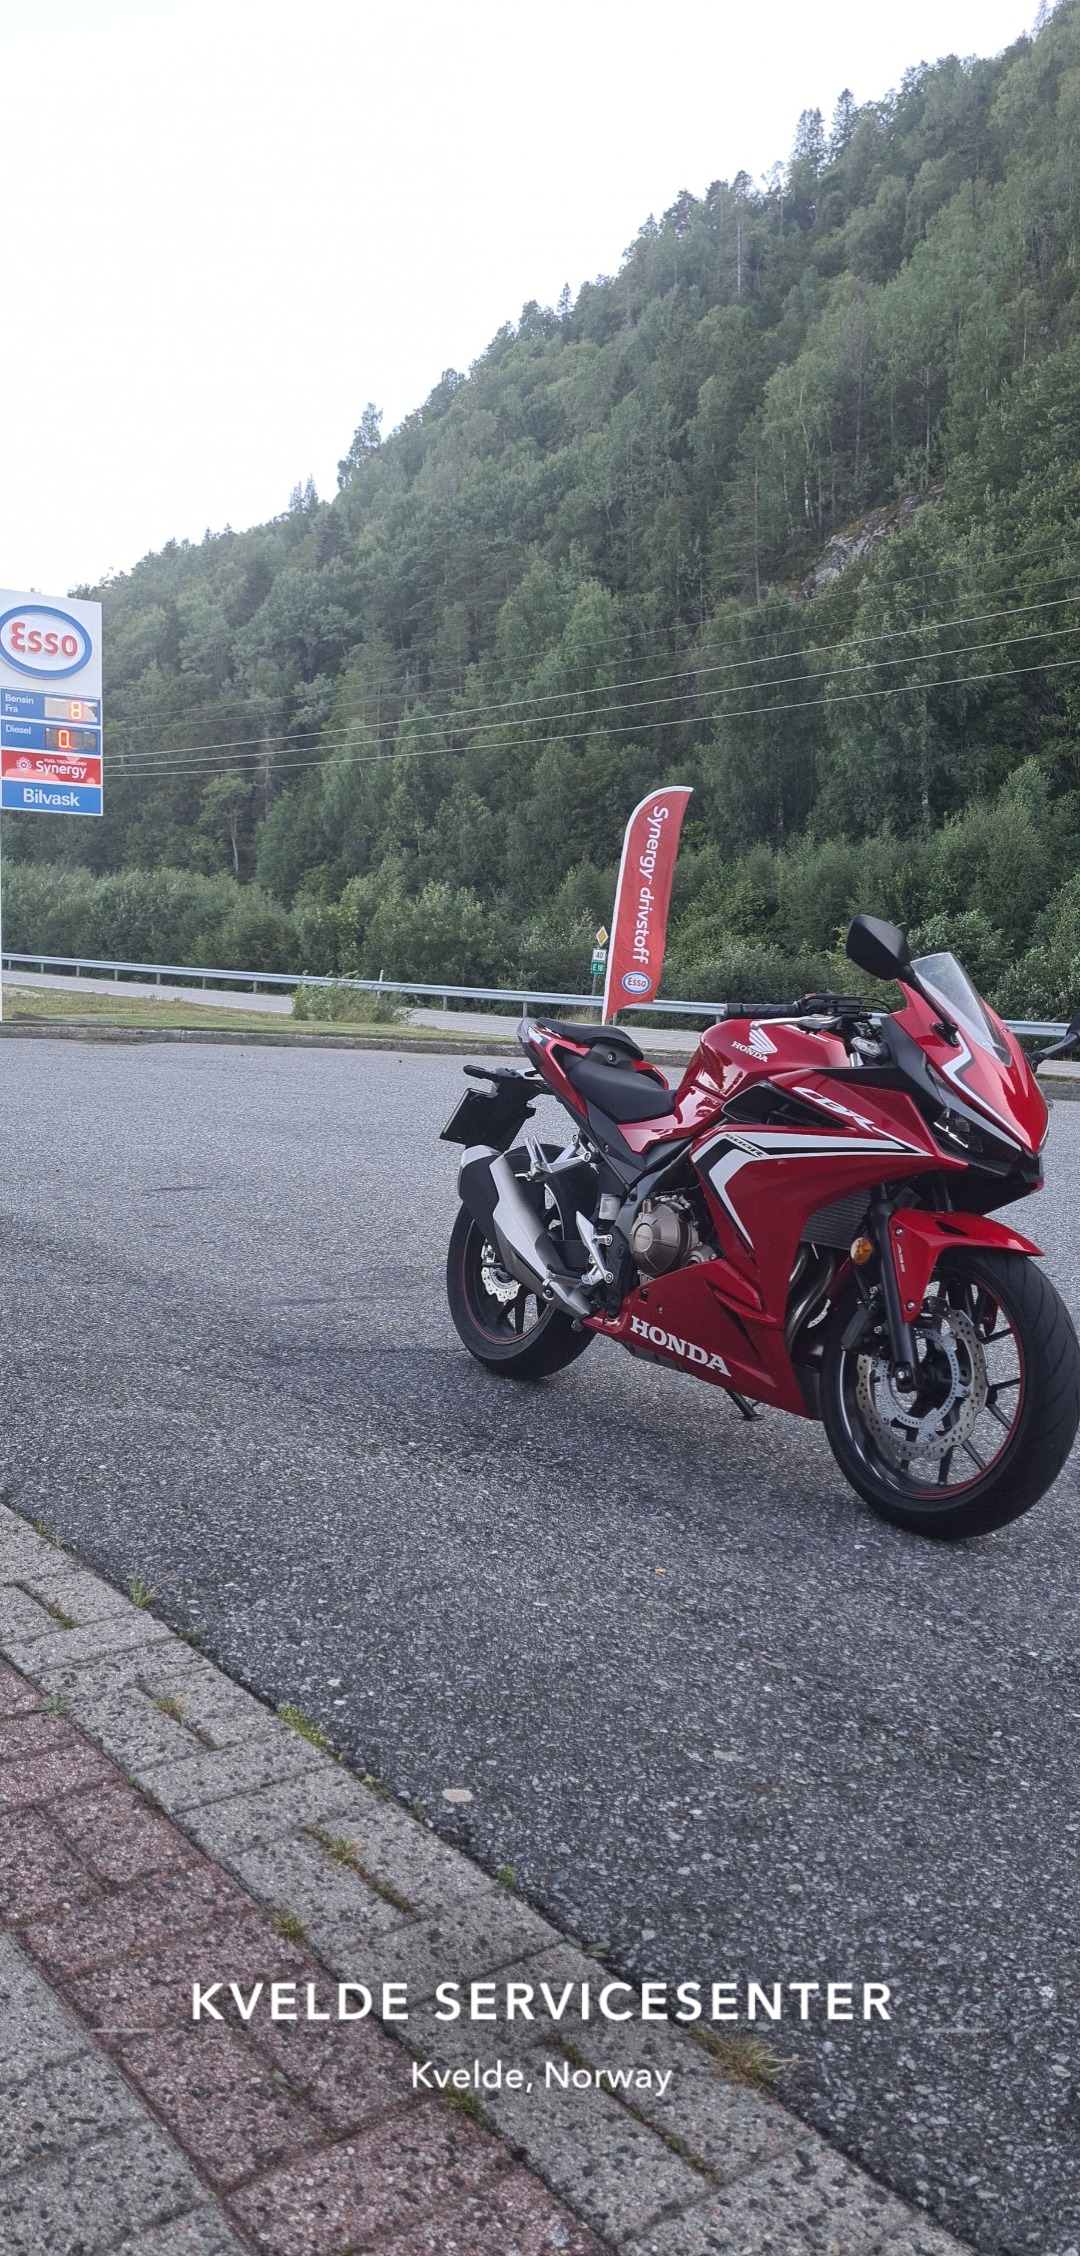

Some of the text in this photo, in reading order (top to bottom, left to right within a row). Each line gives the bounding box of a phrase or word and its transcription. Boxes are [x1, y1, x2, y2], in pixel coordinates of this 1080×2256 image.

[10, 621, 79, 658] Esso
[4, 693, 35, 704] Bensin
[4, 704, 19, 713] Fra
[5, 724, 32, 735] Diesel
[35, 760, 88, 780] Synergy
[22, 787, 81, 808] Bilvask
[632, 886, 655, 965] drivstoff
[595, 951, 604, 959] 40
[731, 1040, 768, 1063] HONDA
[629, 1314, 732, 1378] HONDA
